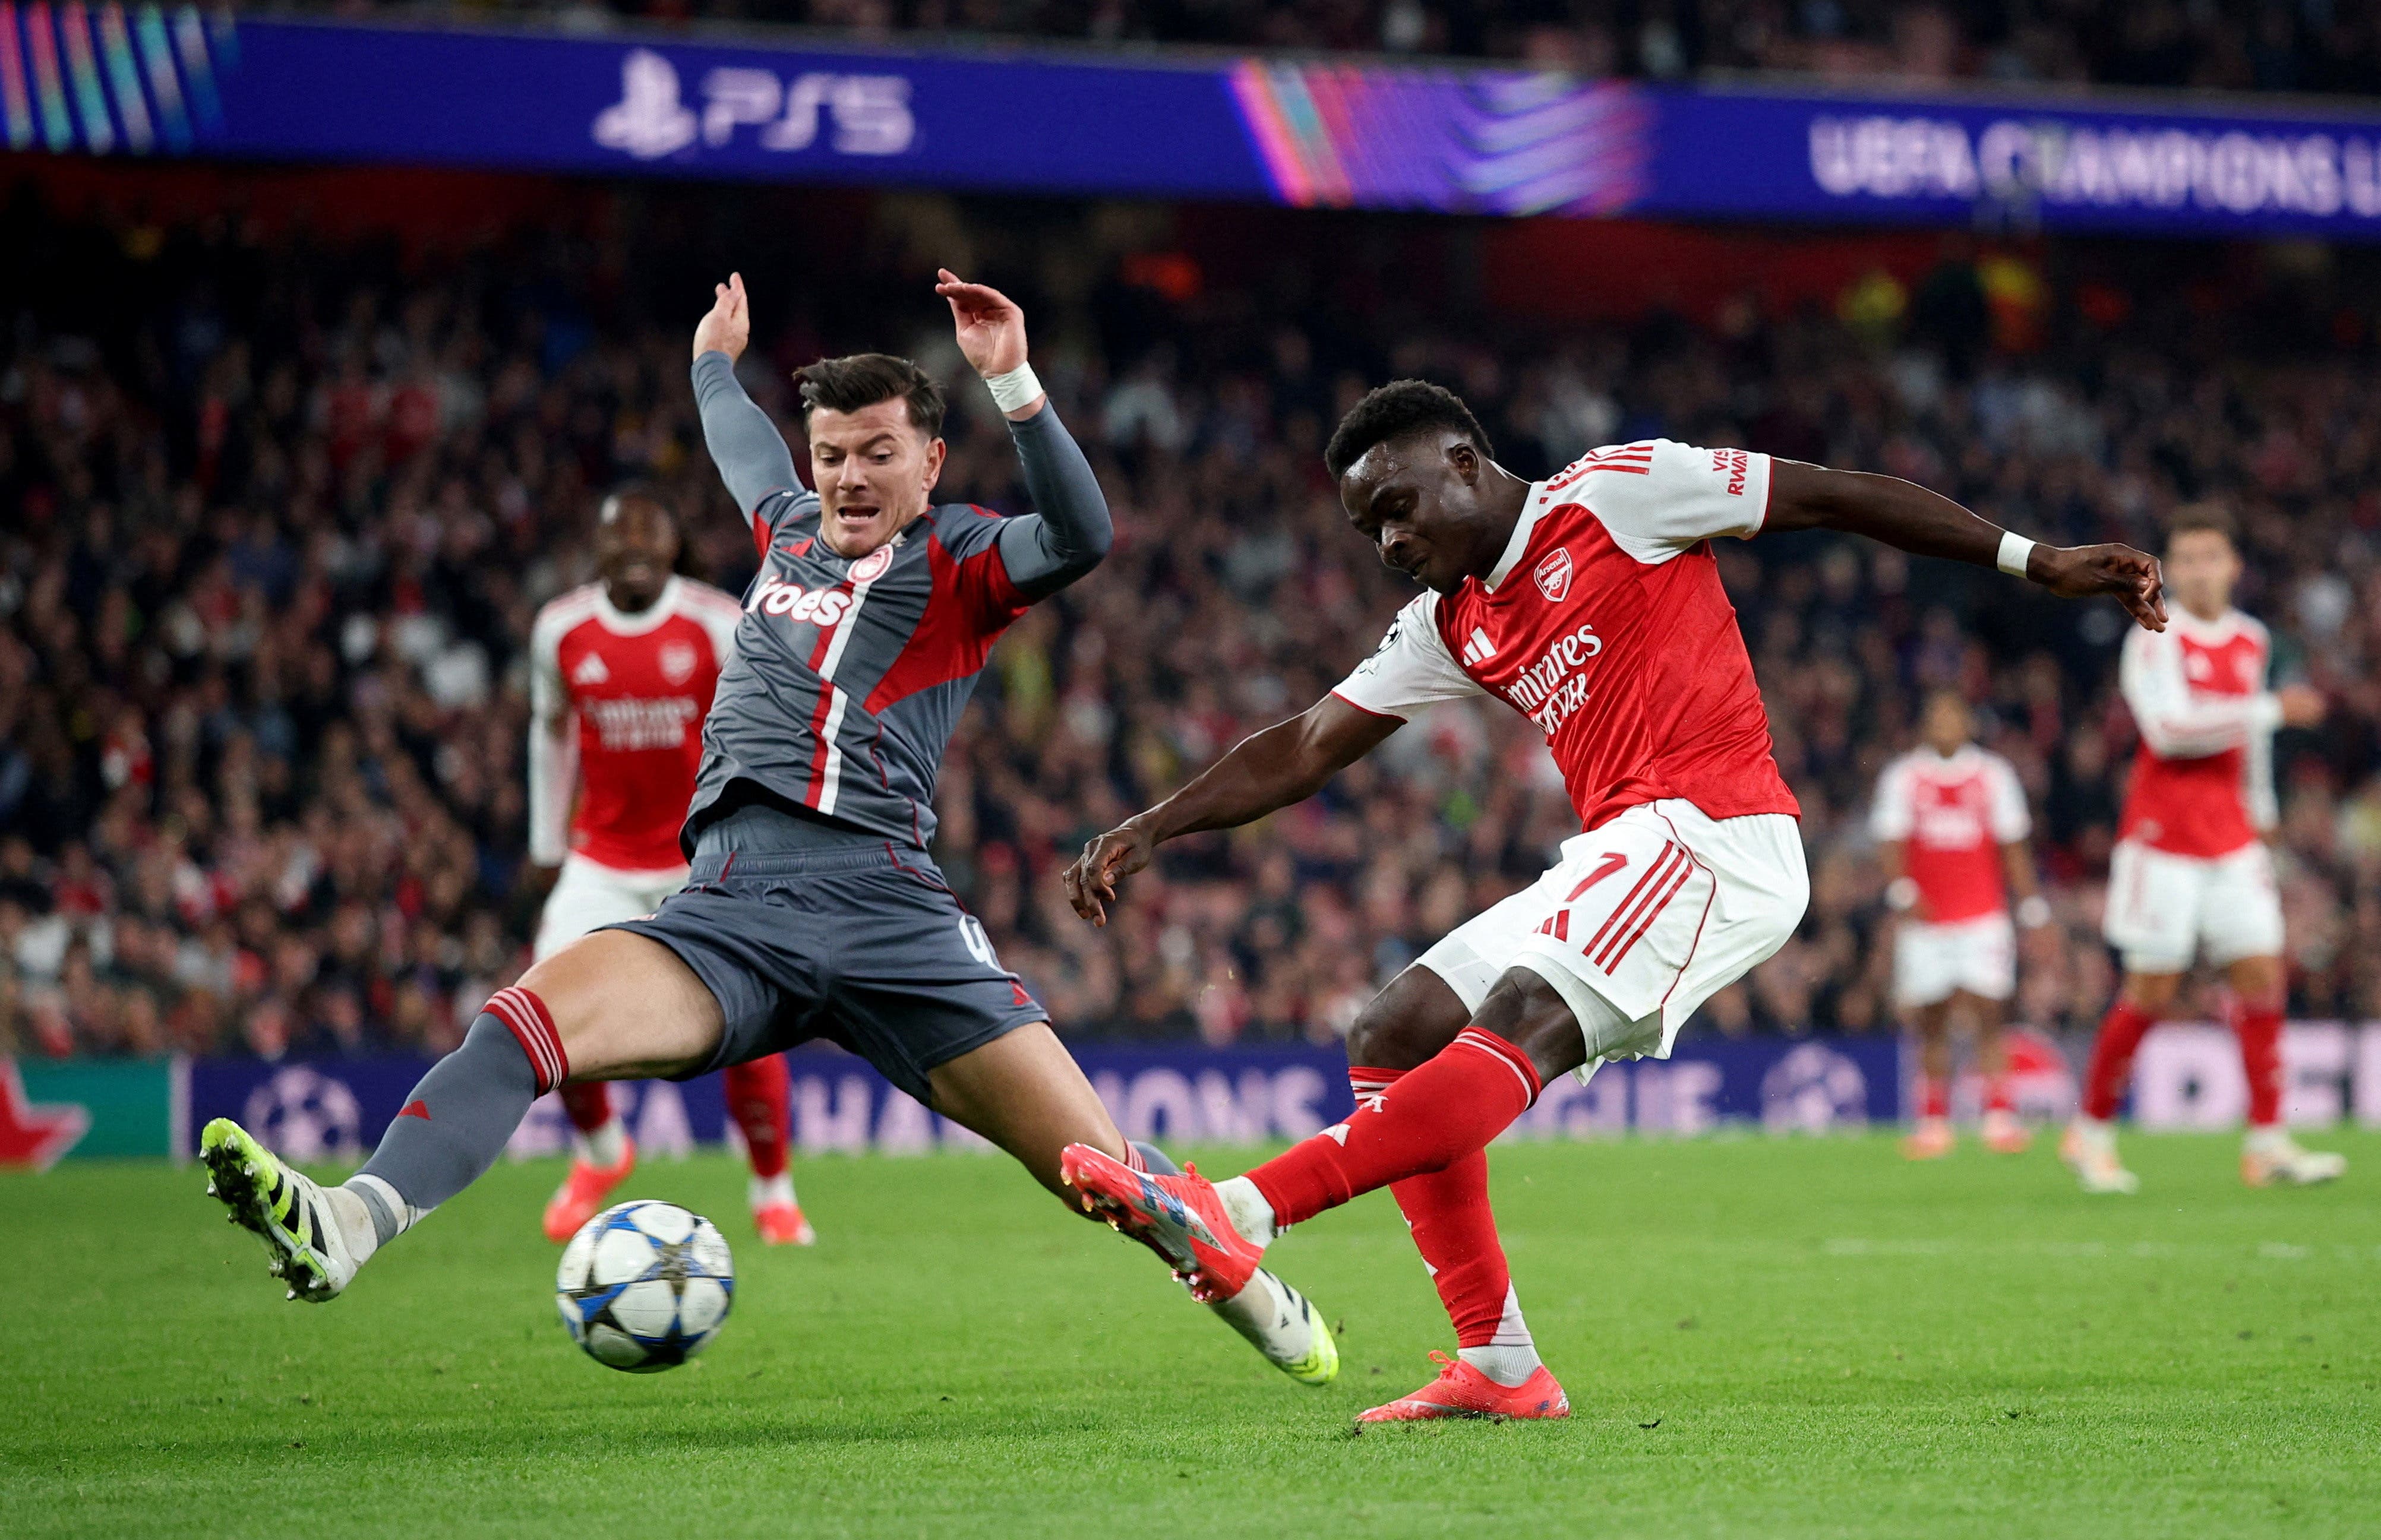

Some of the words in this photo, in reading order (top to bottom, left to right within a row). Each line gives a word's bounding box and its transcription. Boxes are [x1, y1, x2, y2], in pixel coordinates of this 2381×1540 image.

[701, 67, 914, 155] PS5
[1810, 117, 1978, 198] UEFA
[1539, 555, 1565, 578] Arsenal
[1499, 624, 1602, 713] mirates
[1564, 852, 1629, 903] 7
